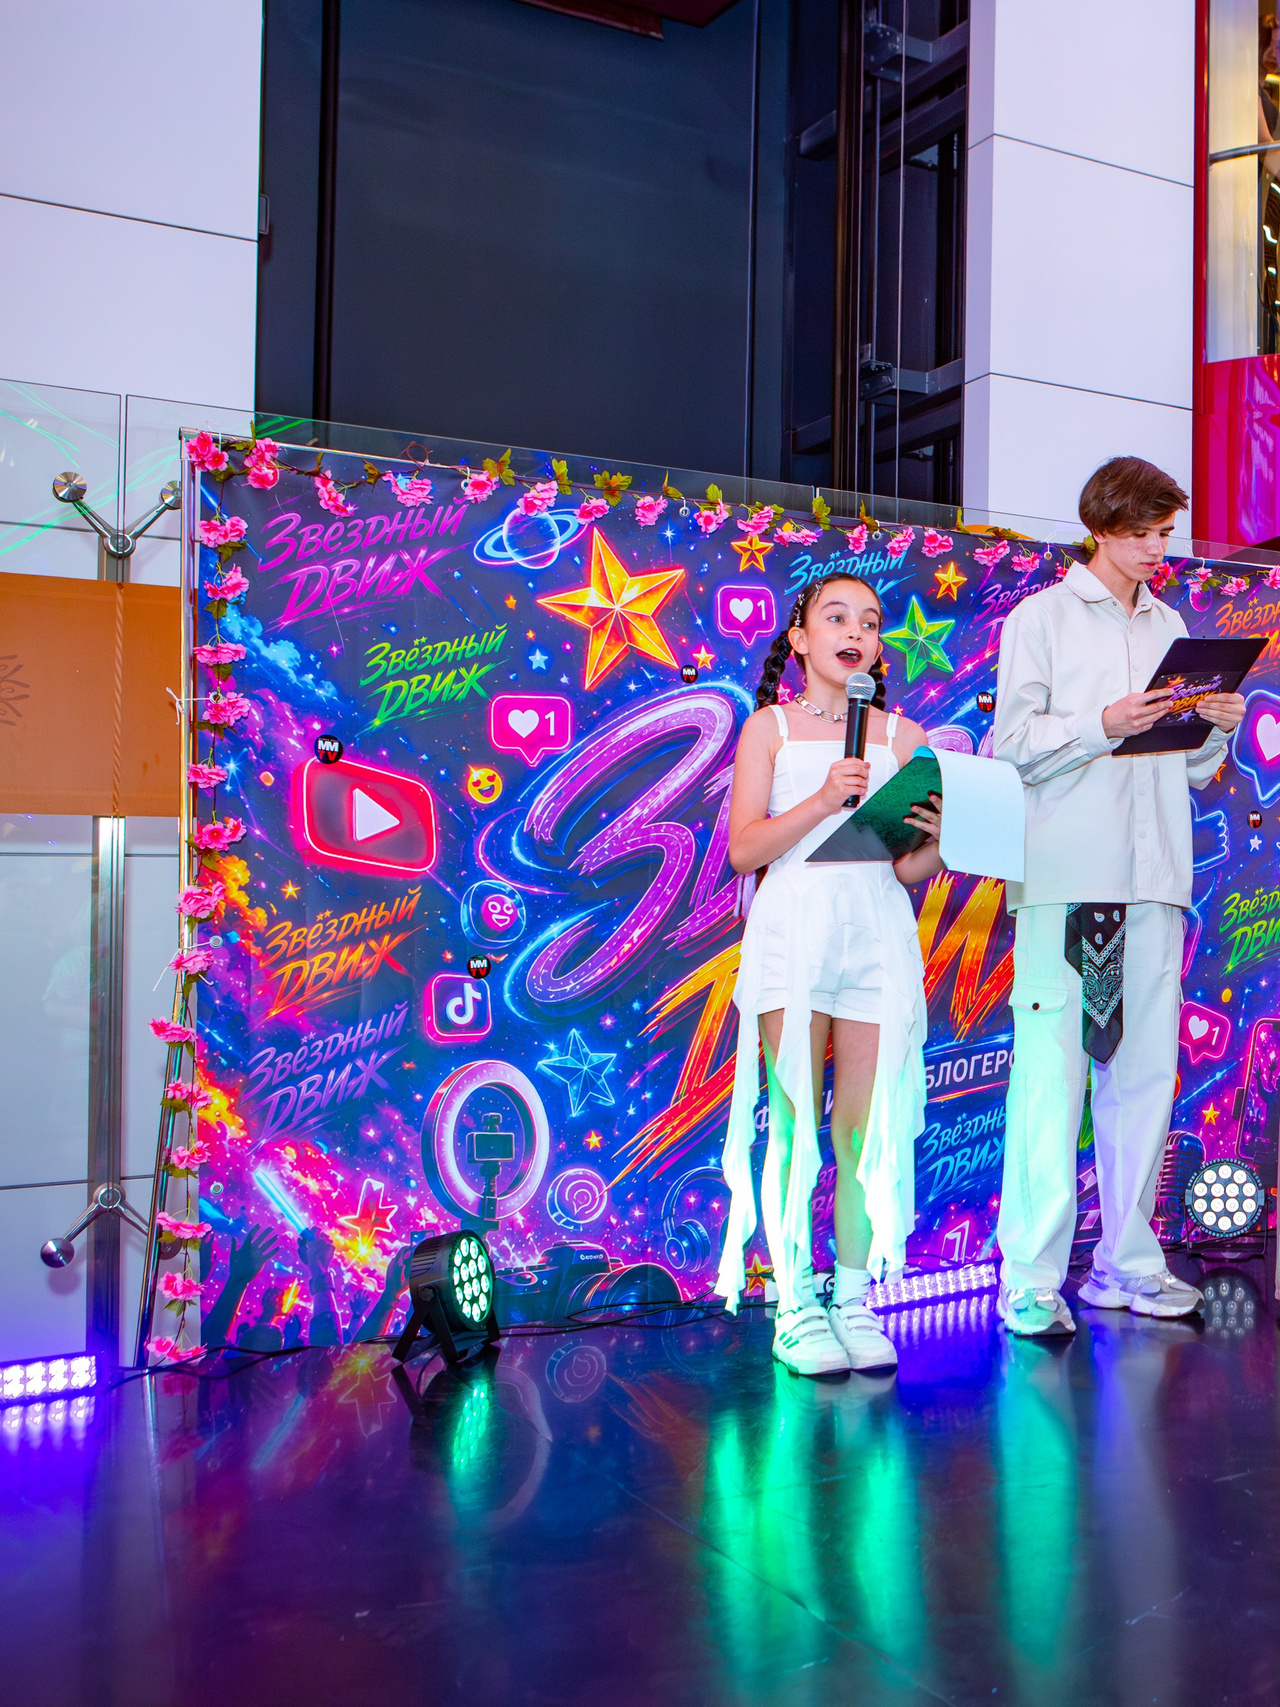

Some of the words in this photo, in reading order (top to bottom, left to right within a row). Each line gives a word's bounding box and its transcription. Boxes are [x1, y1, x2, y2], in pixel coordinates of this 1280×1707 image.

[359, 622, 508, 688] Звёздный
[365, 662, 508, 724] ДВИЖ
[259, 885, 422, 970] Звёздный
[267, 932, 426, 1013] ДВИЖ
[241, 1001, 409, 1104] Звёздный
[249, 1049, 409, 1142] ДВИЖ
